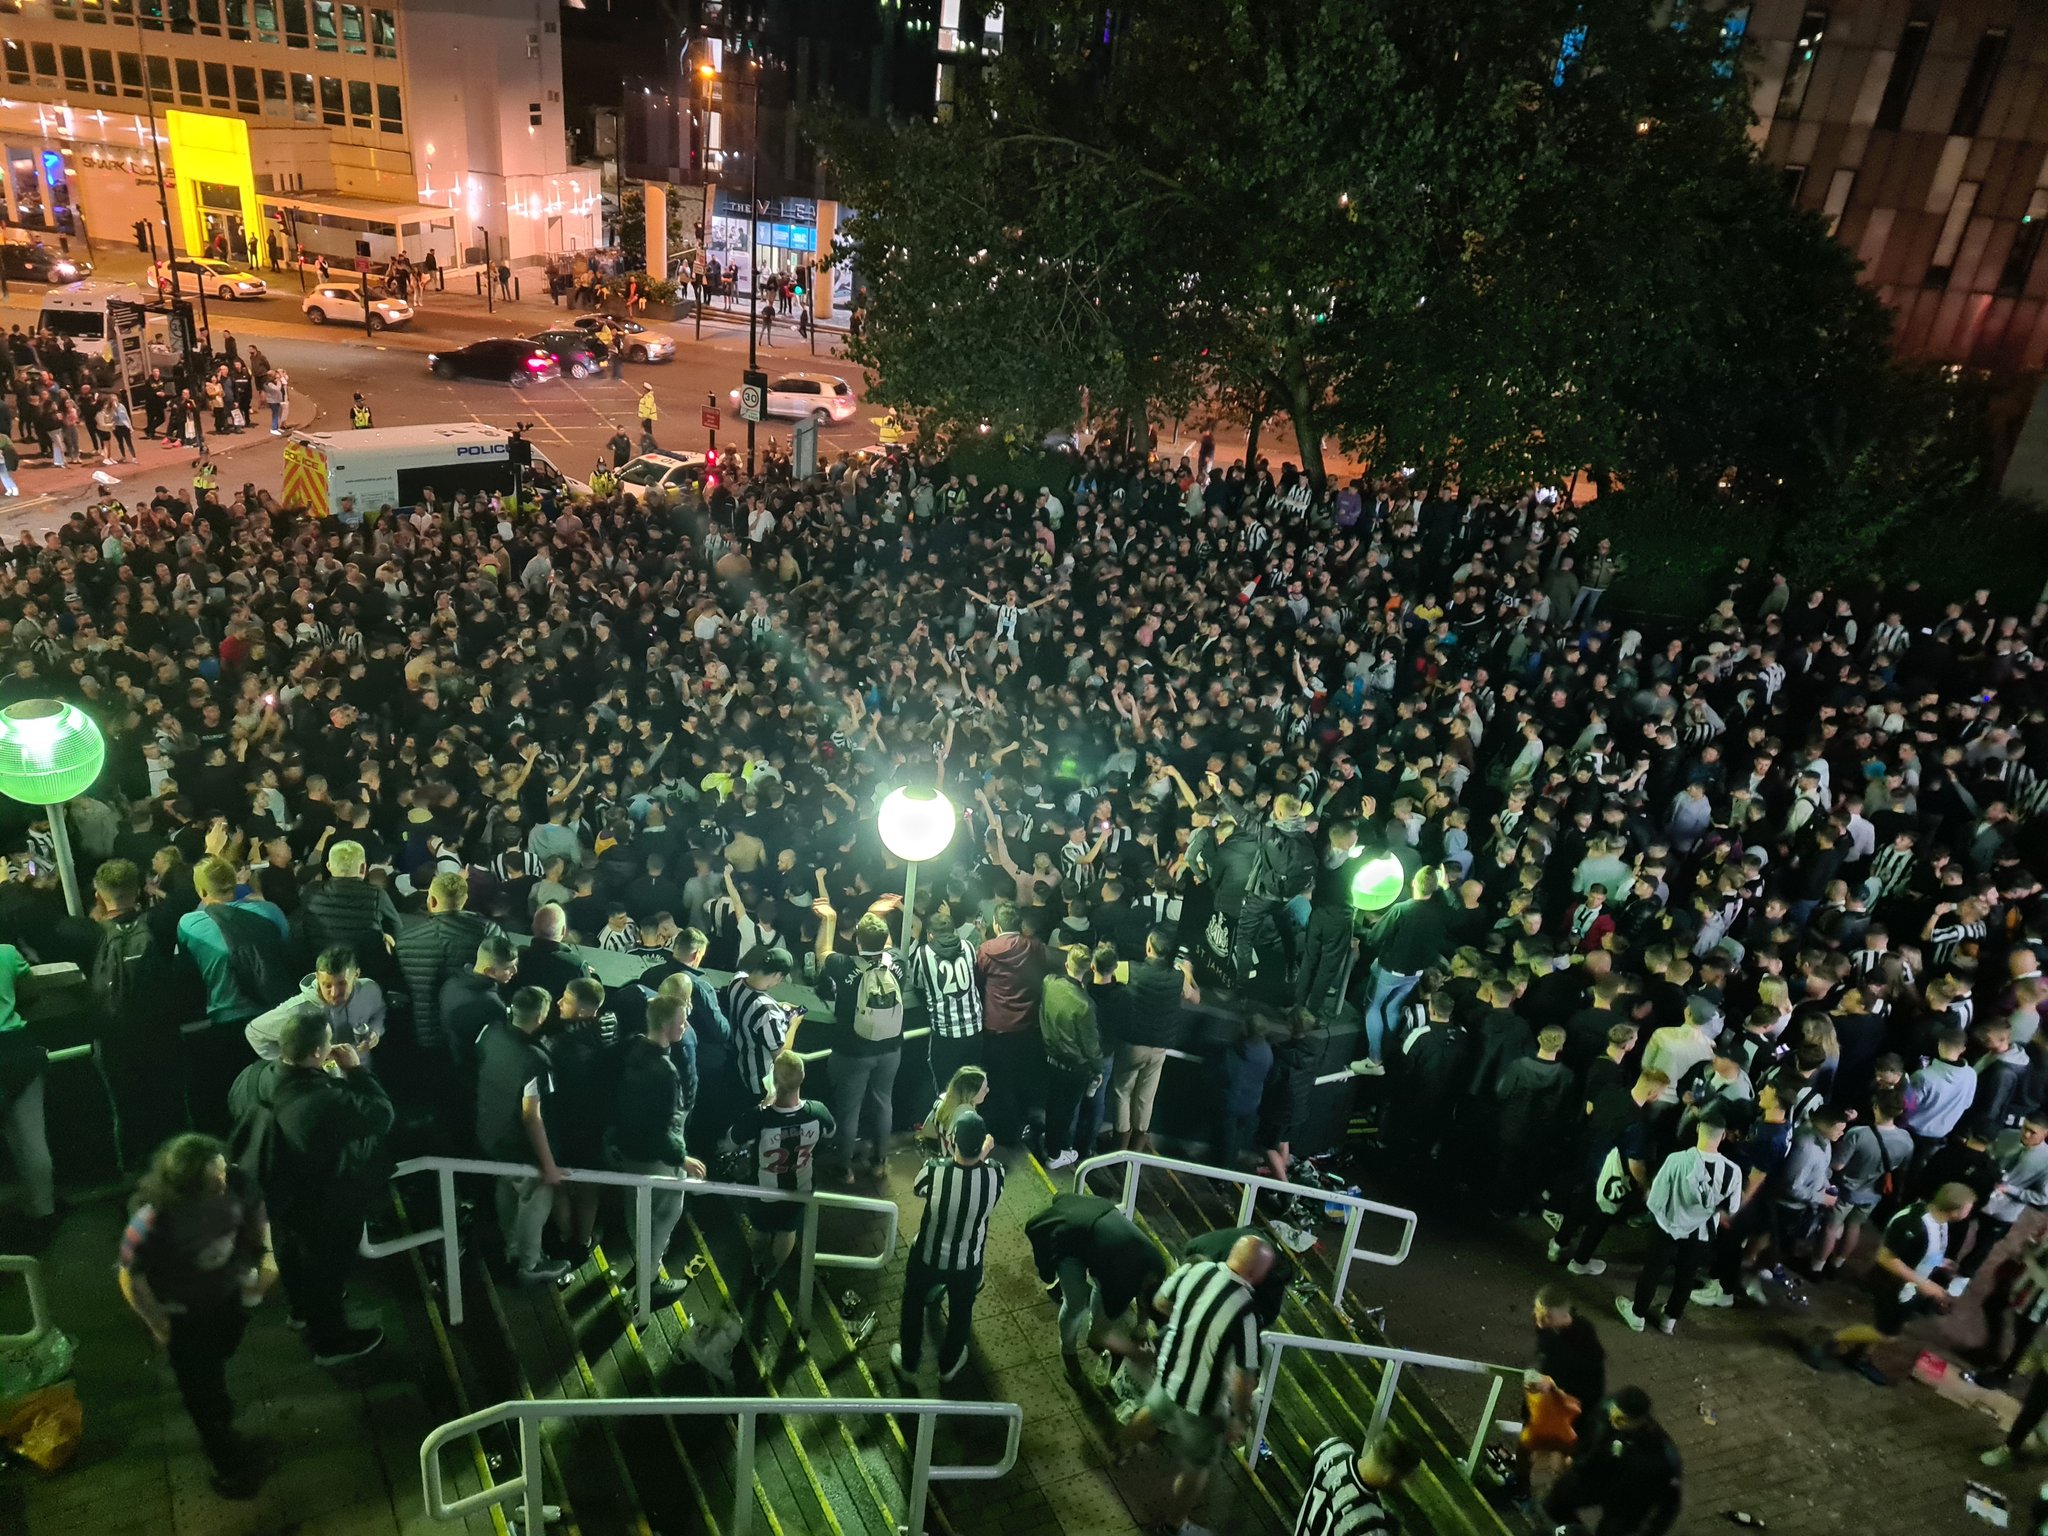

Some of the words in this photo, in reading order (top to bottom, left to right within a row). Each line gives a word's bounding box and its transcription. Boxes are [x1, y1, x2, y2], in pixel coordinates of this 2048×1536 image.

[82, 157, 128, 174] SHARK
[728, 201, 752, 214] THE
[745, 392, 757, 403] 30
[284, 449, 319, 470] POLICE
[938, 956, 970, 994] 20
[763, 1143, 815, 1174] 23
